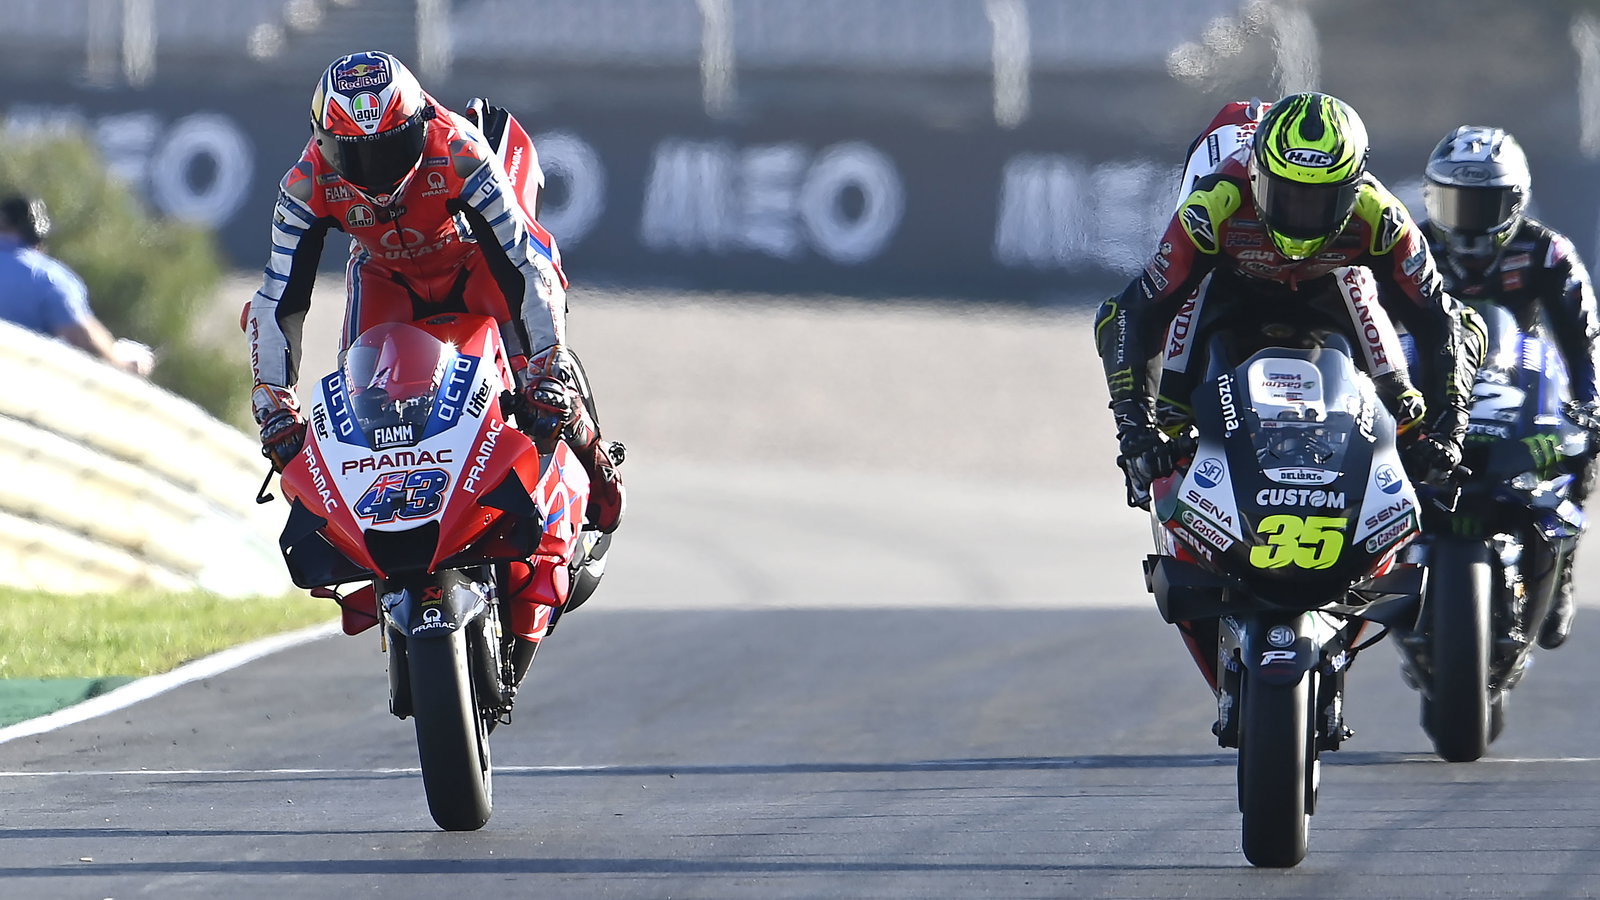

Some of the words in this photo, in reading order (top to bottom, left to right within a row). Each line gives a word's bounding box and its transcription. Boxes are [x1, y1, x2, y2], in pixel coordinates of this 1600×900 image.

[338, 76, 362, 91] Red
[362, 72, 387, 87] Bull
[356, 108, 378, 121] agv
[362, 133, 380, 141] YOU
[1286, 151, 1330, 165] HJC
[1343, 267, 1389, 368] HONDA
[1116, 309, 1127, 364] MONSTER
[328, 374, 355, 437] OCTO
[438, 358, 472, 422] OCTO
[465, 378, 489, 420] Lifter
[1217, 373, 1240, 432] rizoma
[312, 402, 329, 443] Lifter
[374, 424, 414, 444] FIAMM
[341, 448, 454, 476] PRAMAC
[462, 418, 504, 494] PRAMAC
[1197, 460, 1222, 481] SIFI
[302, 444, 338, 514] PRAMAC
[1375, 467, 1398, 488] SIFI
[353, 467, 452, 526] 43
[1186, 489, 1233, 529] SENA
[1256, 488, 1346, 510] CUSTOM
[1364, 497, 1412, 530] SENA
[1192, 519, 1229, 549] Castrol
[1249, 513, 1349, 571] 35
[1377, 518, 1410, 546] Castrol
[412, 621, 456, 635] PRAMAC
